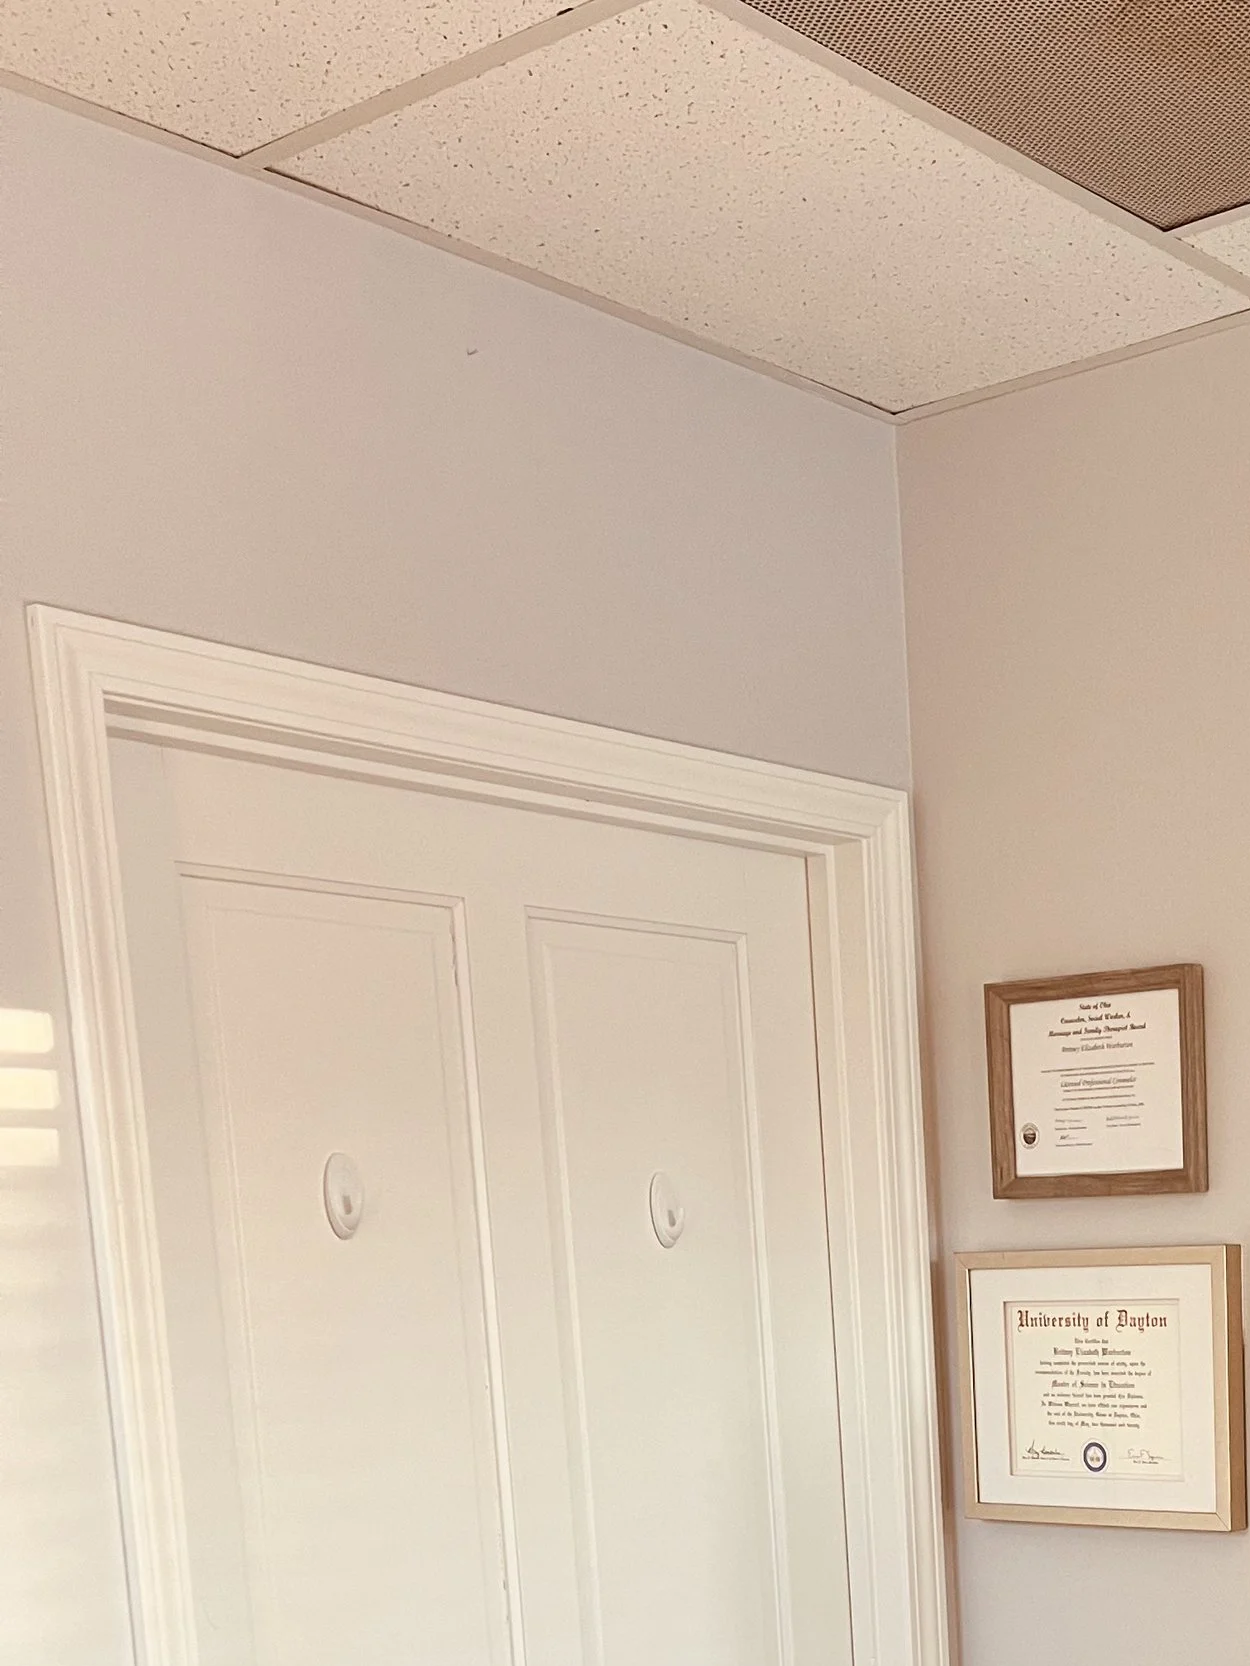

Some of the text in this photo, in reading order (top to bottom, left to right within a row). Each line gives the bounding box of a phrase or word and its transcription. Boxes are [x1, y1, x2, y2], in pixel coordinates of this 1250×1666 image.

[1017, 1309, 1168, 1333] University of Dayton
